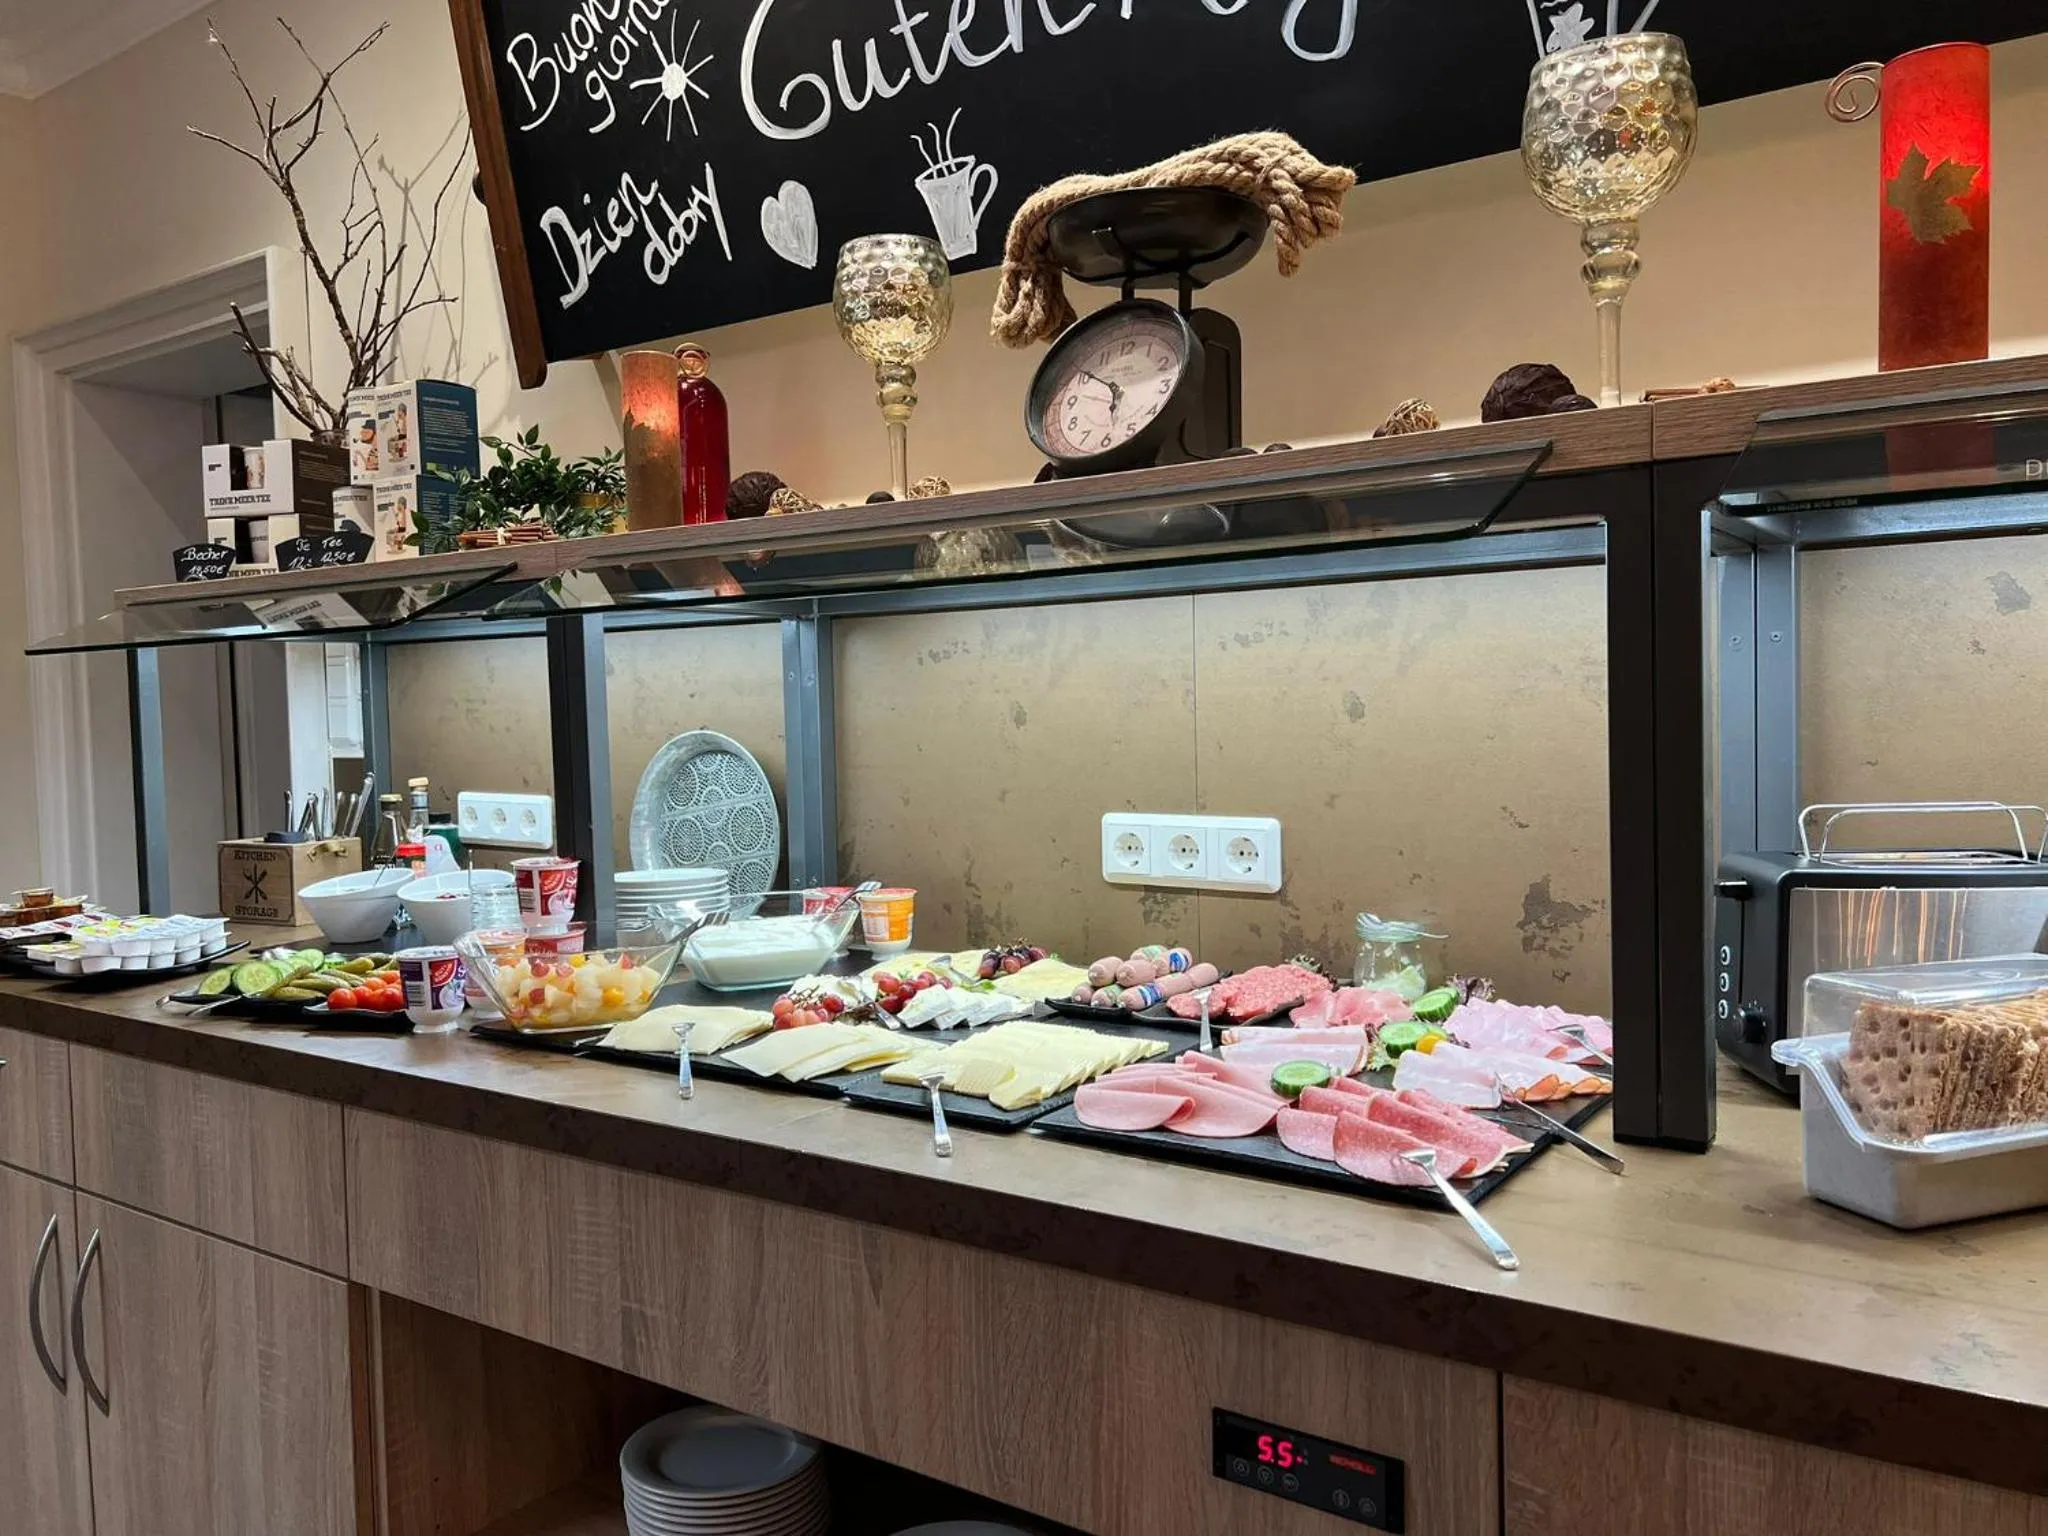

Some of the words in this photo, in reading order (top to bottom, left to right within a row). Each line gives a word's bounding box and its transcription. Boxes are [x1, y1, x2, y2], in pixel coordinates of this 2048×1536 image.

[643, 162, 733, 285] dobry
[1120, 341, 1136, 357] 12
[1100, 351, 1111, 366] 11
[1158, 356, 1170, 372] 2
[1159, 379, 1171, 395] 3
[1067, 395, 1078, 410] 9
[1145, 403, 1158, 418] 4
[1067, 416, 1078, 432] 8
[1125, 423, 1137, 438] 5
[1079, 429, 1092, 446] 7
[1100, 433, 1112, 448] 6
[322, 536, 343, 549] Tee
[180, 547, 228, 562] Becher
[234, 850, 277, 861] KITCHEN
[235, 905, 279, 917] STORAGE
